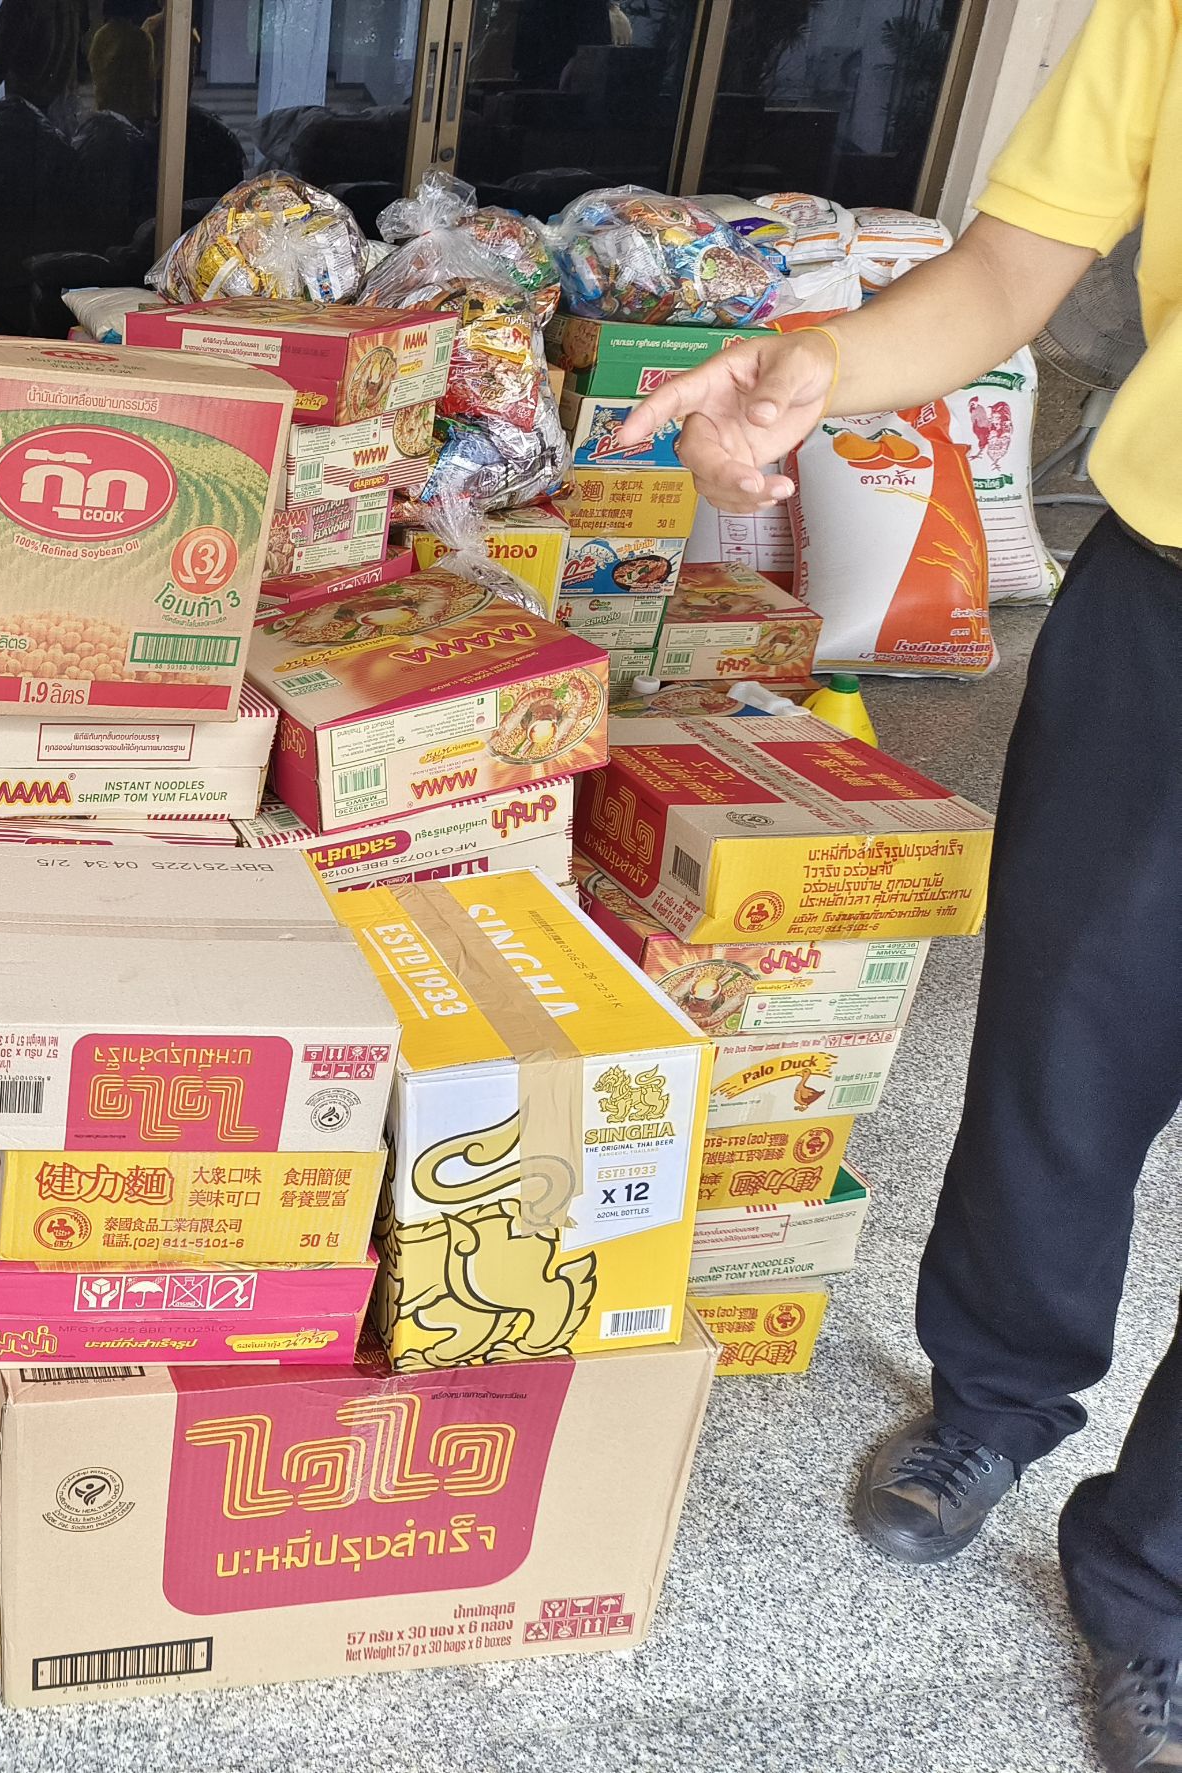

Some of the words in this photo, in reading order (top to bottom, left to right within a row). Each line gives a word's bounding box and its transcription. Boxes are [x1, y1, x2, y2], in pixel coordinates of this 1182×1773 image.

[28, 386, 158, 413] น้ำมันถั่วเหลืองผ่านกรรมวิธี
[860, 470, 916, 487] ตราส้ม
[82, 509, 125, 523] COOK
[13, 534, 39, 552] 100%
[41, 543, 79, 558] Refined
[80, 546, 123, 559] Soybean
[125, 539, 140, 551] Oil
[154, 581, 223, 619] โอเมก้า
[226, 589, 241, 608] 3
[23, 681, 48, 703] 1.9
[49, 682, 85, 706] ลิตร
[104, 781, 150, 792] INSTANT
[154, 780, 205, 790] NOODLES
[411, 768, 477, 800] MAMA
[77, 792, 121, 804] SHRIMP
[123, 792, 148, 802] TOM
[151, 791, 176, 802] YUM
[179, 790, 228, 802] FLAVOUR
[492, 795, 556, 838] มาม่า
[394, 841, 477, 867] MFG100725
[320, 858, 391, 878] BBE100126
[759, 940, 821, 974] มาม่า
[408, 967, 468, 1018] 1933
[94, 1042, 252, 1073] บะหมี่ปรุงสำเร็จ
[743, 1065, 774, 1084] Palo
[780, 1056, 818, 1072] Duck
[89, 1074, 260, 1143] ไวไว
[584, 1121, 676, 1146] SINGHA
[601, 1143, 634, 1152] ORIGINAL
[636, 1141, 654, 1149] THAI
[655, 1139, 674, 1147] BEER
[283, 1167, 351, 1187] 食用簡便
[627, 1165, 657, 1176] 1933
[188, 1190, 260, 1207] 美味可口
[280, 1190, 347, 1208] 營養豐富
[624, 1182, 650, 1202] 12
[597, 1209, 618, 1219] 620ML
[621, 1207, 649, 1217] BOTTLES
[104, 1217, 242, 1233] 泰國食品工業有限公司
[162, 1238, 244, 1249] 811-5101-6
[299, 1233, 319, 1247] 30
[325, 1231, 339, 1247] 包
[709, 1263, 748, 1273] INSTANT
[751, 1257, 795, 1269] NOODLES
[725, 1271, 747, 1281] TOM
[749, 1268, 770, 1278] YUM
[772, 1263, 814, 1275] FLAVOUR
[85, 1338, 198, 1351] บะหมี่กึ่งสำเร็จรูป
[185, 1393, 516, 1521] ไวไว
[215, 1513, 497, 1578] บะหมี่ปรุงสำเร็จ
[454, 1602, 515, 1619] น้ำหนักสุทธิ
[347, 1631, 364, 1644] 57
[368, 1628, 393, 1643] กรัม
[408, 1626, 425, 1639] 30
[428, 1624, 453, 1638] ซอง
[468, 1622, 477, 1633] 6
[346, 1648, 361, 1662] Net
[363, 1645, 396, 1661] Weight
[397, 1643, 411, 1656] 57
[428, 1641, 441, 1653] 30
[443, 1639, 465, 1654] bags
[484, 1634, 511, 1648] boxes
